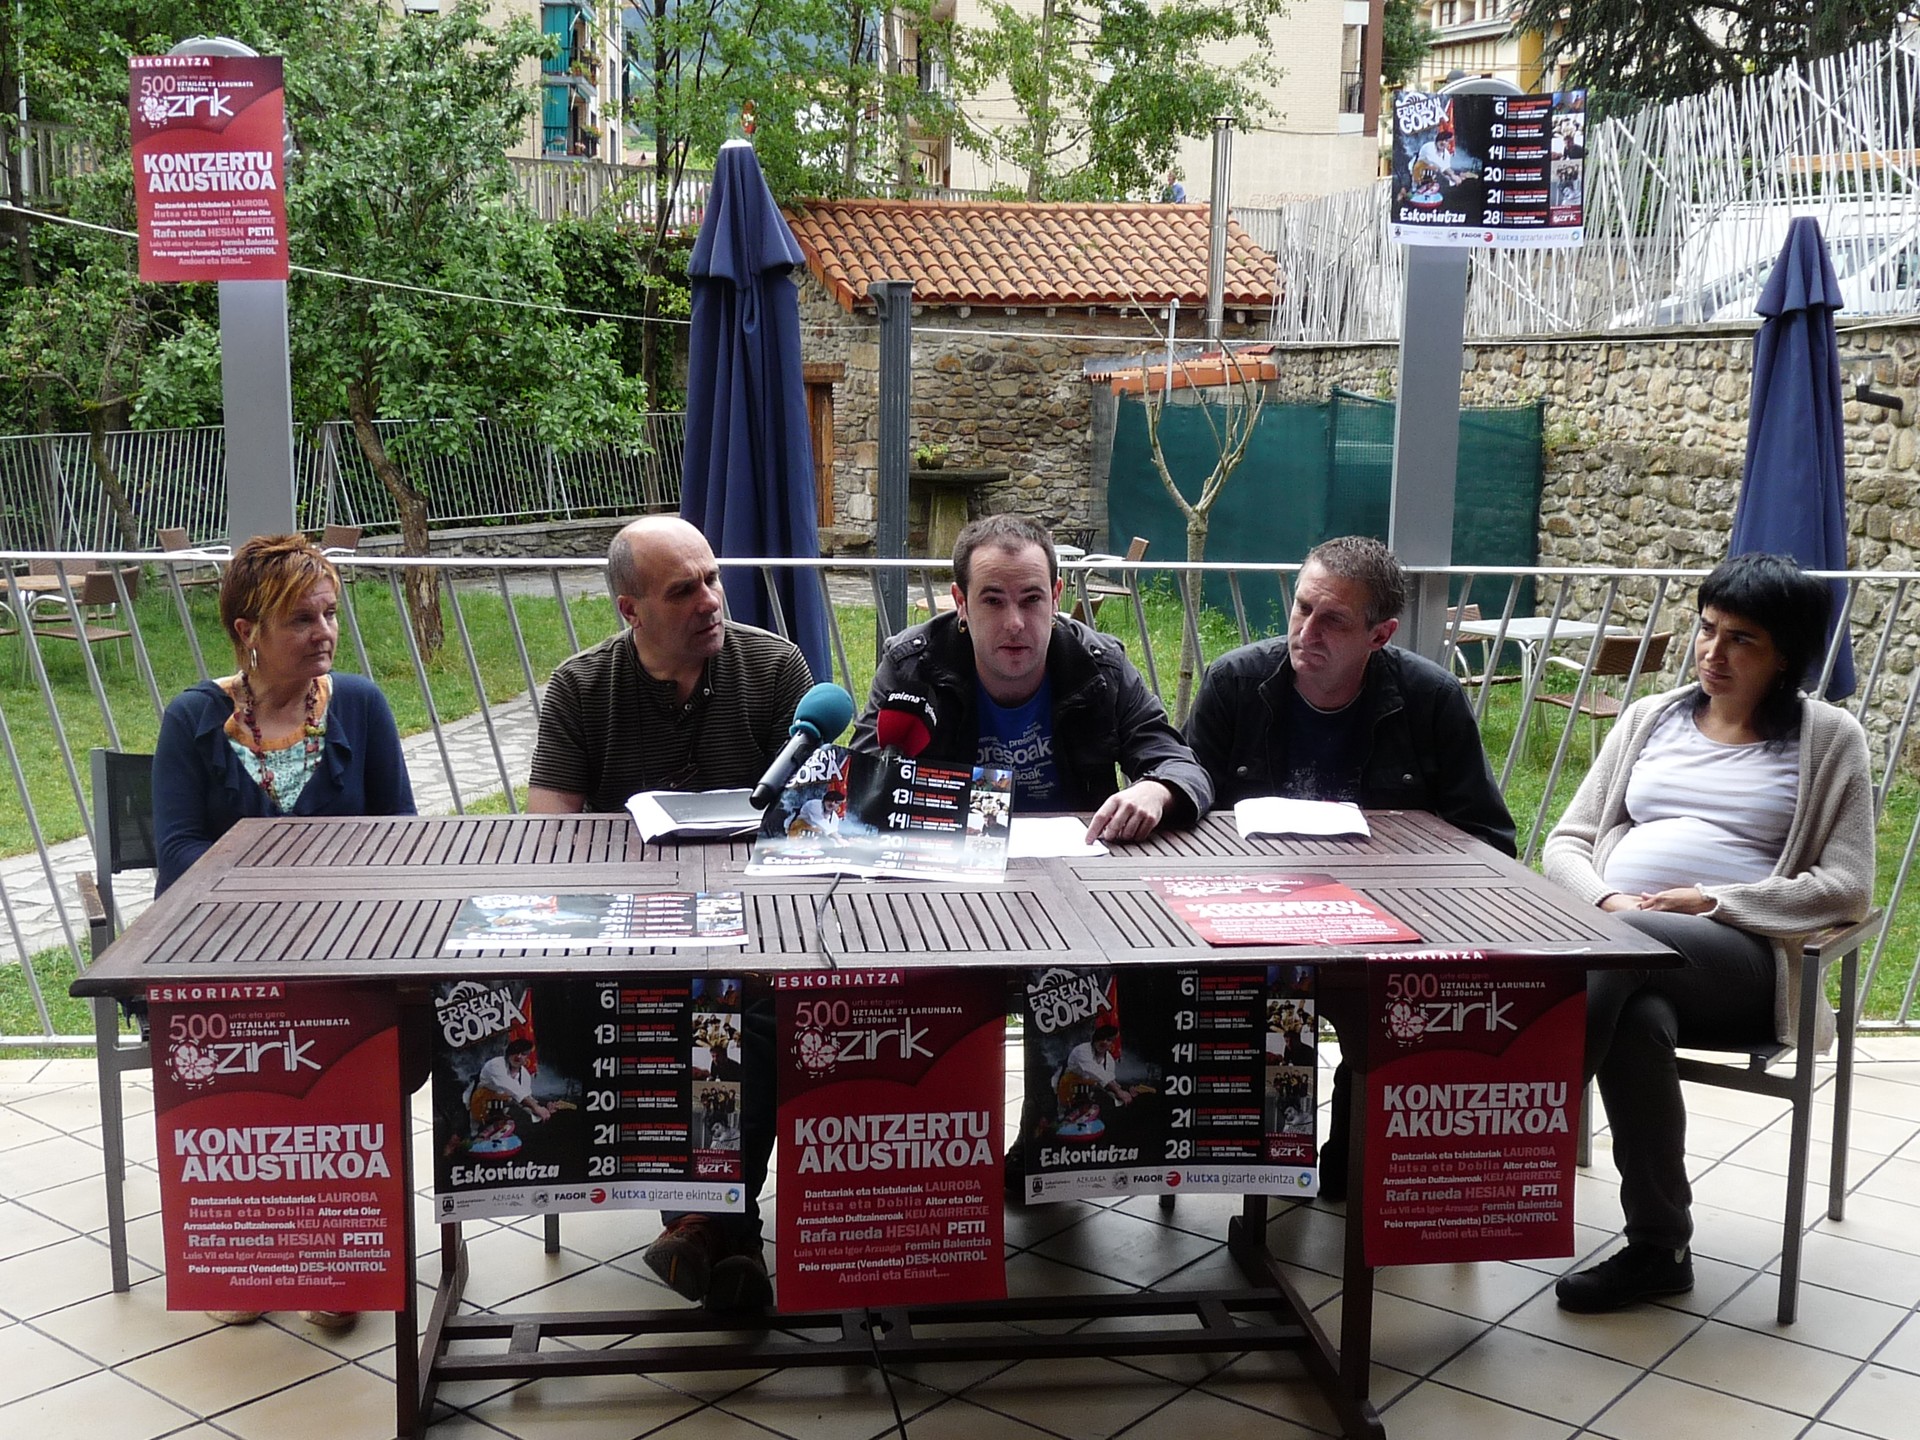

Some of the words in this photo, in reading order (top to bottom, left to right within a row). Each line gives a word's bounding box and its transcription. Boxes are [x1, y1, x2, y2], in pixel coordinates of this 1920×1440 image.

[130, 58, 210, 68] ESKORIATZA
[141, 75, 176, 94] 500
[1397, 96, 1442, 120] ERREKAN
[1495, 102, 1504, 115] 6
[1400, 108, 1449, 134] GORA
[1490, 124, 1504, 138] 13
[1488, 146, 1503, 160] 14
[143, 151, 272, 173] KONTZERTU
[149, 171, 276, 193] AKUSTIKOA
[1483, 167, 1502, 181] 20
[1487, 189, 1501, 204] 21
[1400, 207, 1466, 223] Eskoriatza
[1483, 210, 1500, 225] 28
[153, 229, 177, 238] Rafa
[178, 229, 206, 238] rueda
[208, 228, 244, 237] HESIAN
[248, 226, 274, 237] PETTI
[1520, 233, 1543, 243] gizarte
[1545, 233, 1569, 241] ekintza
[887, 691, 920, 704] golena
[900, 765, 912, 779] 6
[892, 789, 909, 805] 13
[888, 812, 907, 829] 14
[778, 973, 900, 988] ESKORIATZA
[1181, 977, 1195, 996] 6
[1386, 973, 1438, 999] 500
[1440, 982, 1481, 990] UZTAILAK
[1496, 981, 1546, 989] LARUNBATA
[150, 986, 281, 1001] ESKORIATZA
[600, 989, 615, 1009] 6
[1029, 973, 1099, 1012] ERREKAN
[437, 986, 513, 1026] ERREKAN
[795, 1000, 850, 1027] 500
[852, 1009, 895, 1017] UZTAILAK
[910, 1006, 963, 1015] LARUNBATA
[1035, 986, 1112, 1033] GORA
[169, 1013, 227, 1040] 500
[229, 1021, 276, 1030] UZTAILAK
[294, 1018, 350, 1027] LARUNBATA
[443, 999, 527, 1048] GORA
[1174, 1010, 1194, 1031] 13
[230, 1029, 280, 1037] 19:30etan
[594, 1024, 615, 1045] 13
[1172, 1043, 1193, 1064] 14
[592, 1057, 615, 1078] 14
[1165, 1075, 1192, 1096] 20
[586, 1090, 615, 1112] 20
[1383, 1081, 1567, 1111] KONTZERTU
[1171, 1108, 1191, 1128] 21
[1385, 1108, 1569, 1138] AKUSTIKOA
[593, 1123, 615, 1145] 21
[795, 1111, 990, 1145] KONTZERTU
[174, 1123, 384, 1155] KONTZERTU
[798, 1138, 994, 1174] AKUSTIKOA
[1040, 1144, 1139, 1167] Eskoriatza
[1165, 1139, 1191, 1160] 28
[1391, 1152, 1438, 1161] Dantzariak
[1439, 1152, 1453, 1160] eta
[1454, 1149, 1502, 1159] txistulariak
[1504, 1147, 1555, 1158] LAUROBA
[181, 1151, 391, 1183] AKUSTIKOA
[451, 1161, 560, 1186] Eskoriatza
[588, 1156, 615, 1177] 28
[1503, 1162, 1523, 1170] Aitor
[1524, 1161, 1538, 1169] eta
[1540, 1160, 1557, 1169] Oier
[1133, 1175, 1163, 1183] FAGOR
[1186, 1171, 1219, 1183] kutxa
[1222, 1173, 1256, 1185] gizarte
[1258, 1173, 1295, 1184] ekintza
[555, 1192, 586, 1200] FAGOR
[612, 1187, 646, 1199] kutxa
[648, 1189, 684, 1201] gizarte
[686, 1189, 723, 1201] ekintza
[805, 1189, 854, 1199] Dantzariak
[856, 1188, 871, 1196] eta
[872, 1185, 924, 1195] txistulariak
[925, 1180, 981, 1192] LAUROBA
[1386, 1190, 1419, 1202] Rafa
[1422, 1189, 1462, 1201] rueda
[1465, 1185, 1516, 1198] HESIAN
[1522, 1184, 1557, 1196] PETTI
[190, 1196, 243, 1205] Dantzariak
[244, 1197, 260, 1205] eta
[261, 1195, 316, 1205] txistulariak
[318, 1192, 378, 1203] LAUROBA
[803, 1201, 844, 1213] Hutsa
[849, 1200, 872, 1210] eta
[925, 1197, 947, 1206] Aitor
[948, 1197, 963, 1205] eta
[964, 1195, 984, 1204] Oier
[1482, 1202, 1516, 1211] Fermin
[1517, 1200, 1563, 1210] Balentzia
[189, 1208, 232, 1218] Hutsa
[238, 1209, 261, 1218] eta
[318, 1207, 342, 1217] Aitor
[343, 1208, 359, 1216] eta
[360, 1207, 381, 1216] Oier
[796, 1215, 844, 1226] Arrasateko
[905, 1209, 927, 1220] KEU
[928, 1206, 990, 1218] AGIRRETXE
[1384, 1220, 1403, 1228] Peio
[1405, 1220, 1437, 1229] reparaz
[1437, 1217, 1482, 1228] (Vendetta)
[1482, 1213, 1558, 1225] DES-KONTROL
[183, 1222, 233, 1231] Arrasateko
[297, 1219, 320, 1229] KEU
[323, 1218, 387, 1228] AGIRRETXE
[800, 1229, 836, 1244] Rafa
[839, 1226, 883, 1241] rueda
[886, 1222, 941, 1238] HESIAN
[947, 1220, 986, 1235] PETTI
[188, 1234, 226, 1247] Rafa
[229, 1234, 274, 1246] rueda
[278, 1233, 336, 1246] HESIAN
[343, 1232, 384, 1245] PETTI
[1421, 1229, 1459, 1241] Andoni
[1461, 1229, 1478, 1238] eta
[905, 1241, 941, 1251] Fermin
[943, 1237, 992, 1249] Balentzia
[183, 1251, 203, 1260] Luis
[218, 1251, 234, 1259] eta
[235, 1251, 255, 1261] Igor
[256, 1251, 294, 1261] Arzuaga
[299, 1250, 336, 1259] Fermin
[338, 1248, 391, 1258] Balentzia
[798, 1263, 820, 1272] Peio
[821, 1261, 856, 1272] reparaz
[857, 1257, 904, 1270] (Vendetta)
[906, 1250, 988, 1265] DES-KONTROL
[188, 1264, 211, 1273] Peio
[212, 1265, 248, 1275] reparaz
[249, 1264, 298, 1274] (Vendetta)
[300, 1261, 386, 1272] DES-KONTROL
[229, 1276, 272, 1286] Andoni
[275, 1277, 295, 1286] eta
[838, 1271, 880, 1284] Andoni
[882, 1270, 901, 1281] eta
